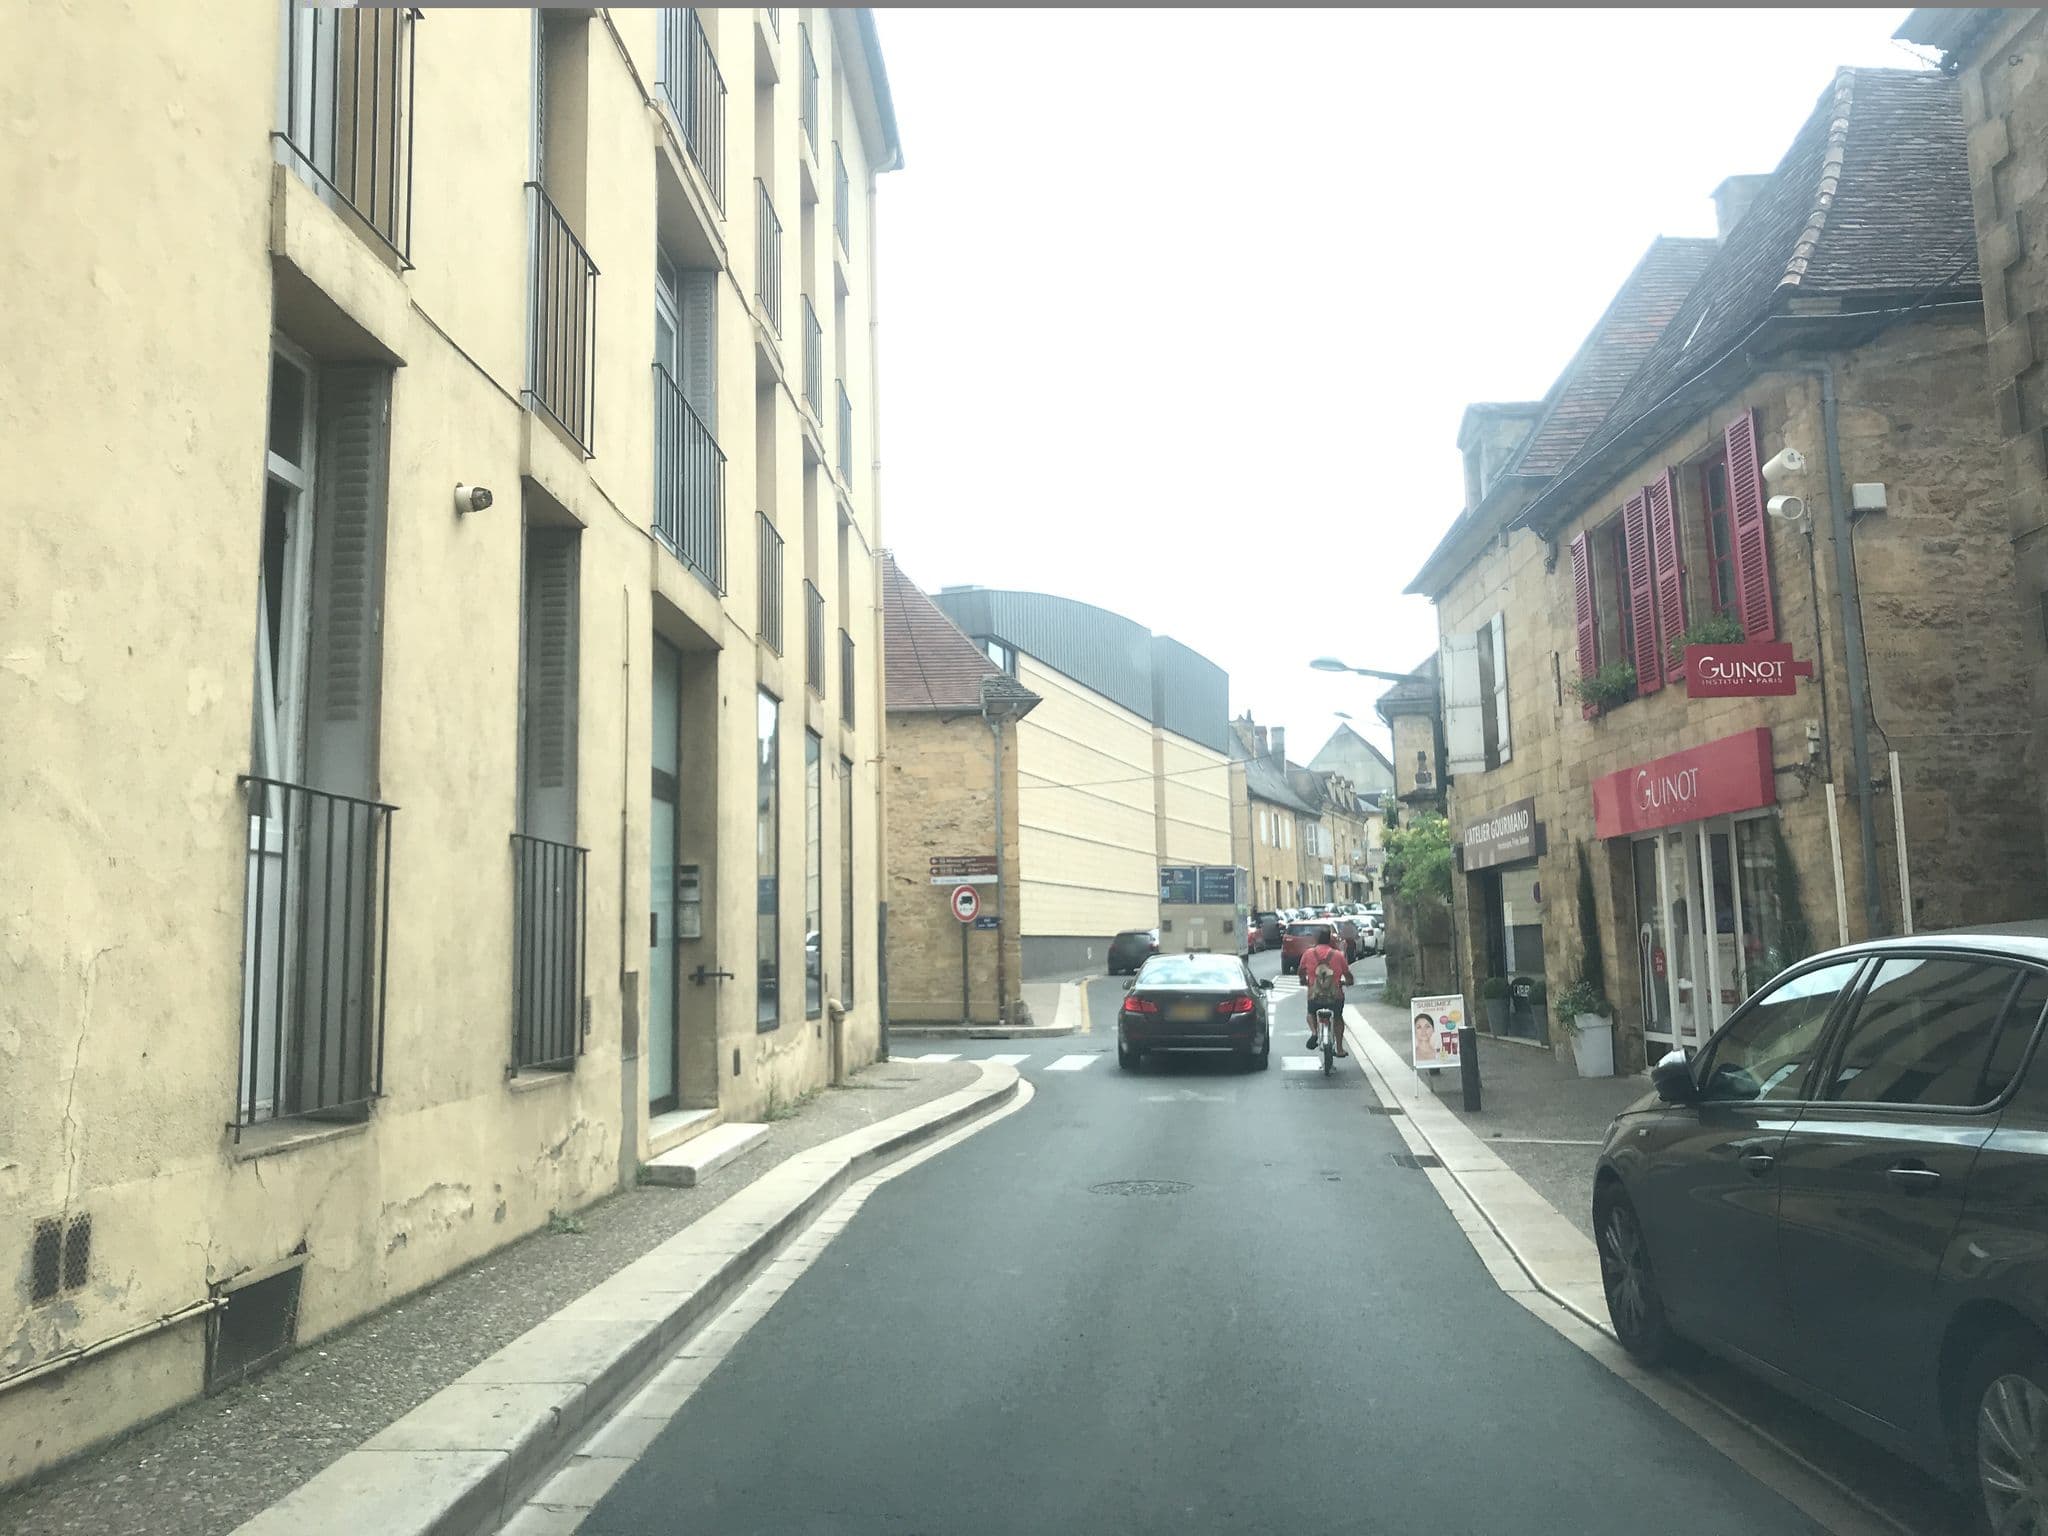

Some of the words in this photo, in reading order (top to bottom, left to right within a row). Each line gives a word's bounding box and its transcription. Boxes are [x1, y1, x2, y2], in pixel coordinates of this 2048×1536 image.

[1698, 656, 1785, 679] GUINOT
[1701, 678, 1744, 686] INSTITUT
[1636, 768, 1698, 811] GUINOT
[1464, 823, 1491, 847] L'ATELIER
[1490, 809, 1529, 839] GOURMAND
